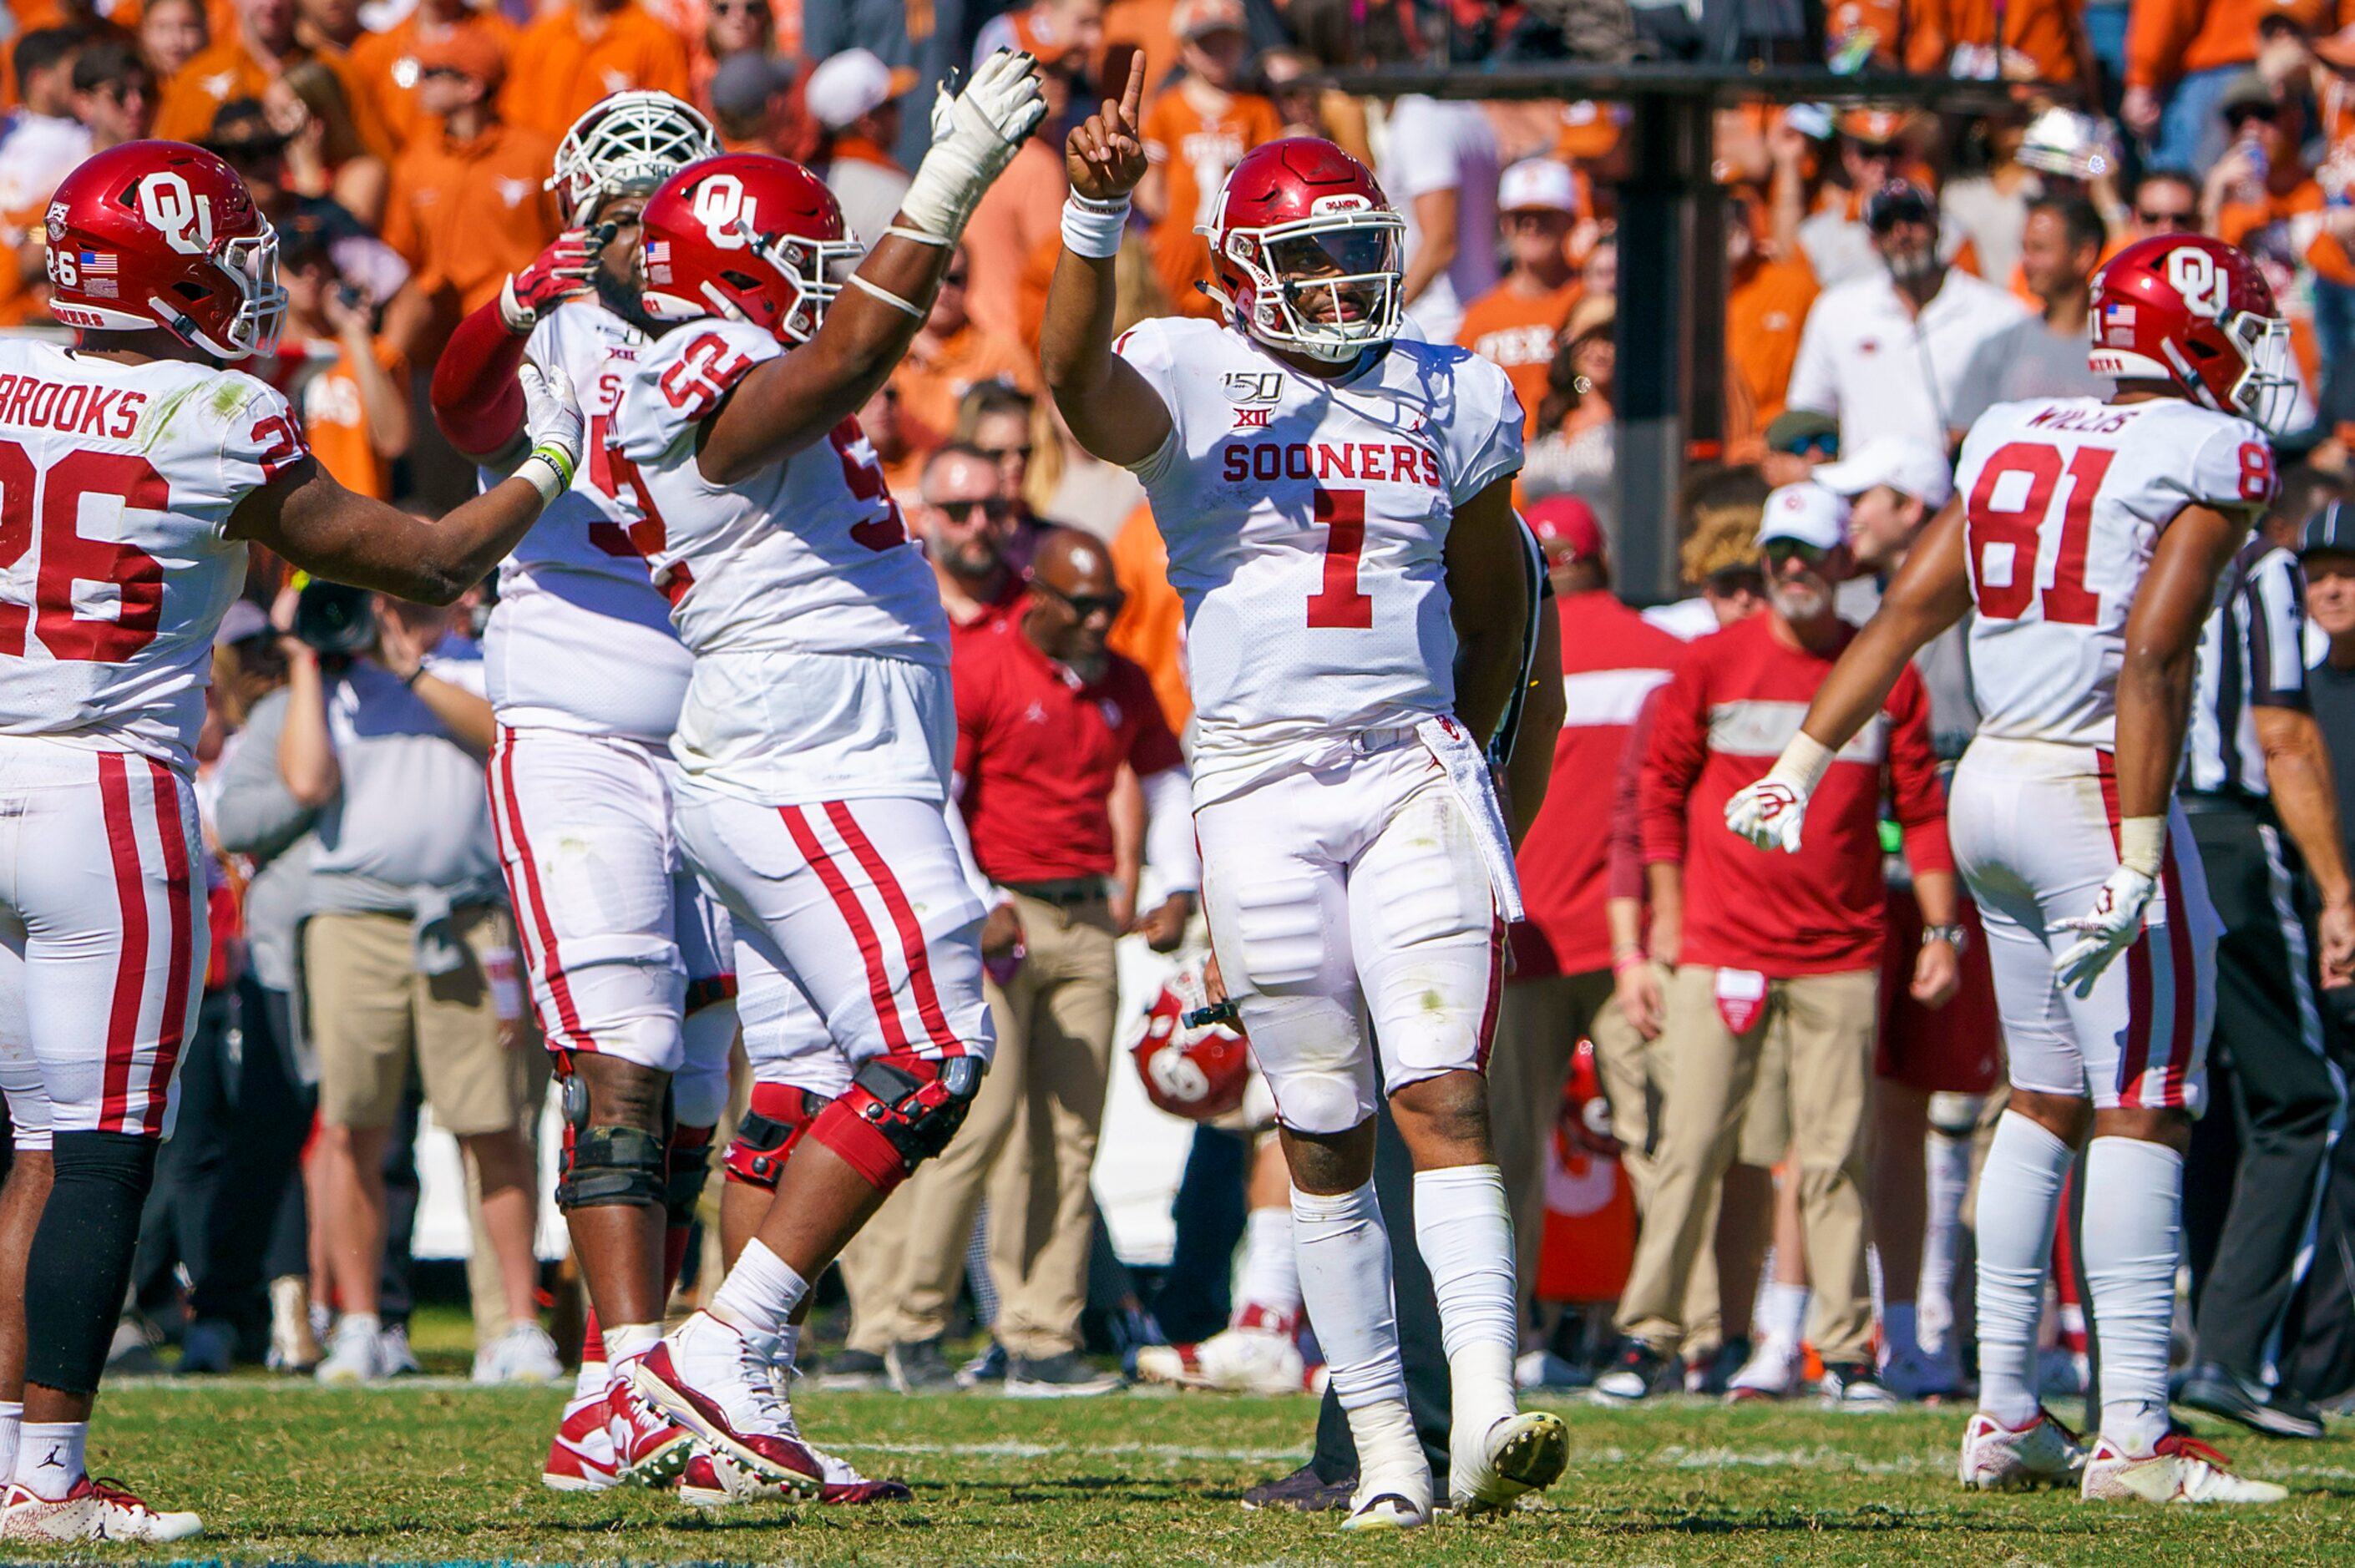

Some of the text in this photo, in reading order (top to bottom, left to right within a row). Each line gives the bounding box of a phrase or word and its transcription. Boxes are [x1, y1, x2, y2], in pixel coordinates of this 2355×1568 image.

[139, 171, 212, 255] OU
[694, 174, 757, 250] OU
[45, 246, 78, 286] 26
[2168, 246, 2229, 318] OU
[0, 374, 147, 439] BROOKS
[660, 331, 755, 422] 52
[1233, 407, 1272, 427] XII
[2027, 406, 2140, 433] WILLIS
[1223, 443, 1441, 487] SOONERS
[2238, 442, 2282, 504] 8
[0, 439, 170, 663] 6
[1307, 489, 1372, 629] 1
[1968, 442, 2117, 626] 81
